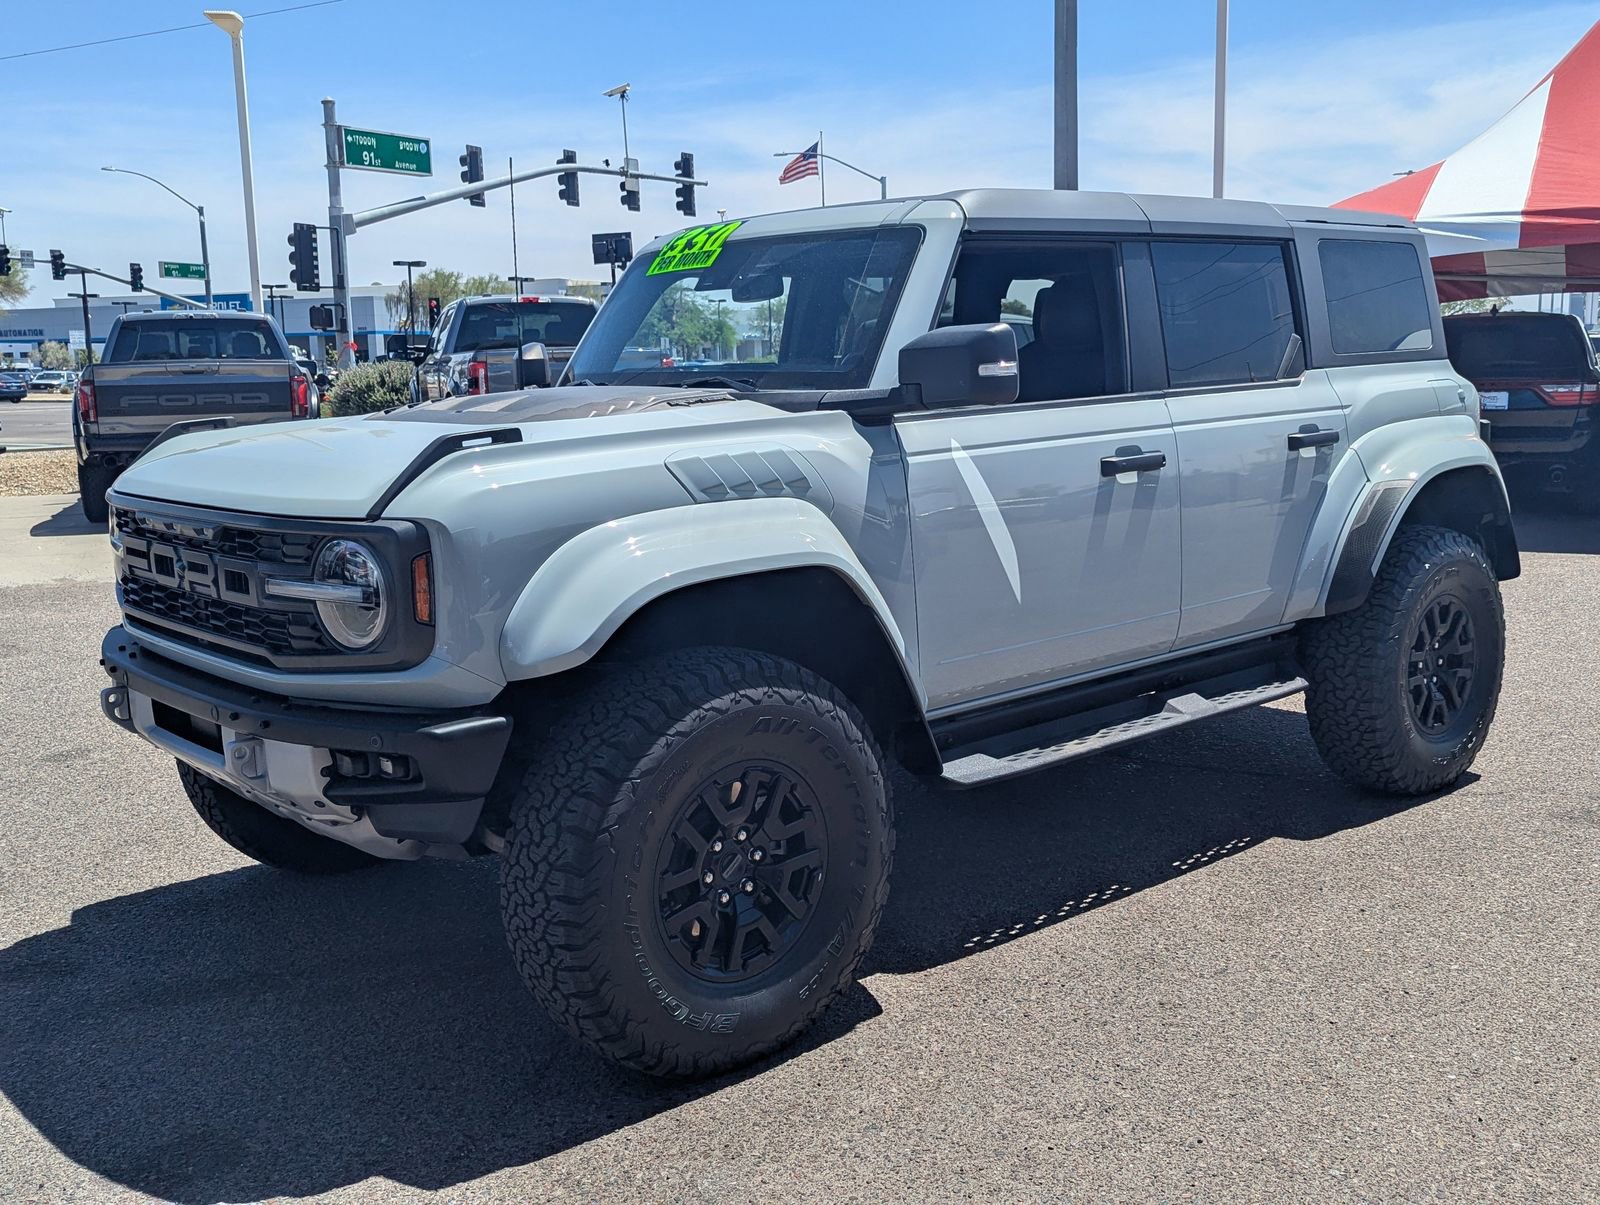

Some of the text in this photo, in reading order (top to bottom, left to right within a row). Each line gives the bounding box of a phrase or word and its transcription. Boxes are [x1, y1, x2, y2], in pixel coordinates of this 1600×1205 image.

[394, 160, 417, 170] Avenue
[652, 249, 716, 273] PER MONTH
[0, 328, 44, 337] AUTONATION
[119, 392, 270, 407] FORD
[121, 534, 262, 607] FORD
